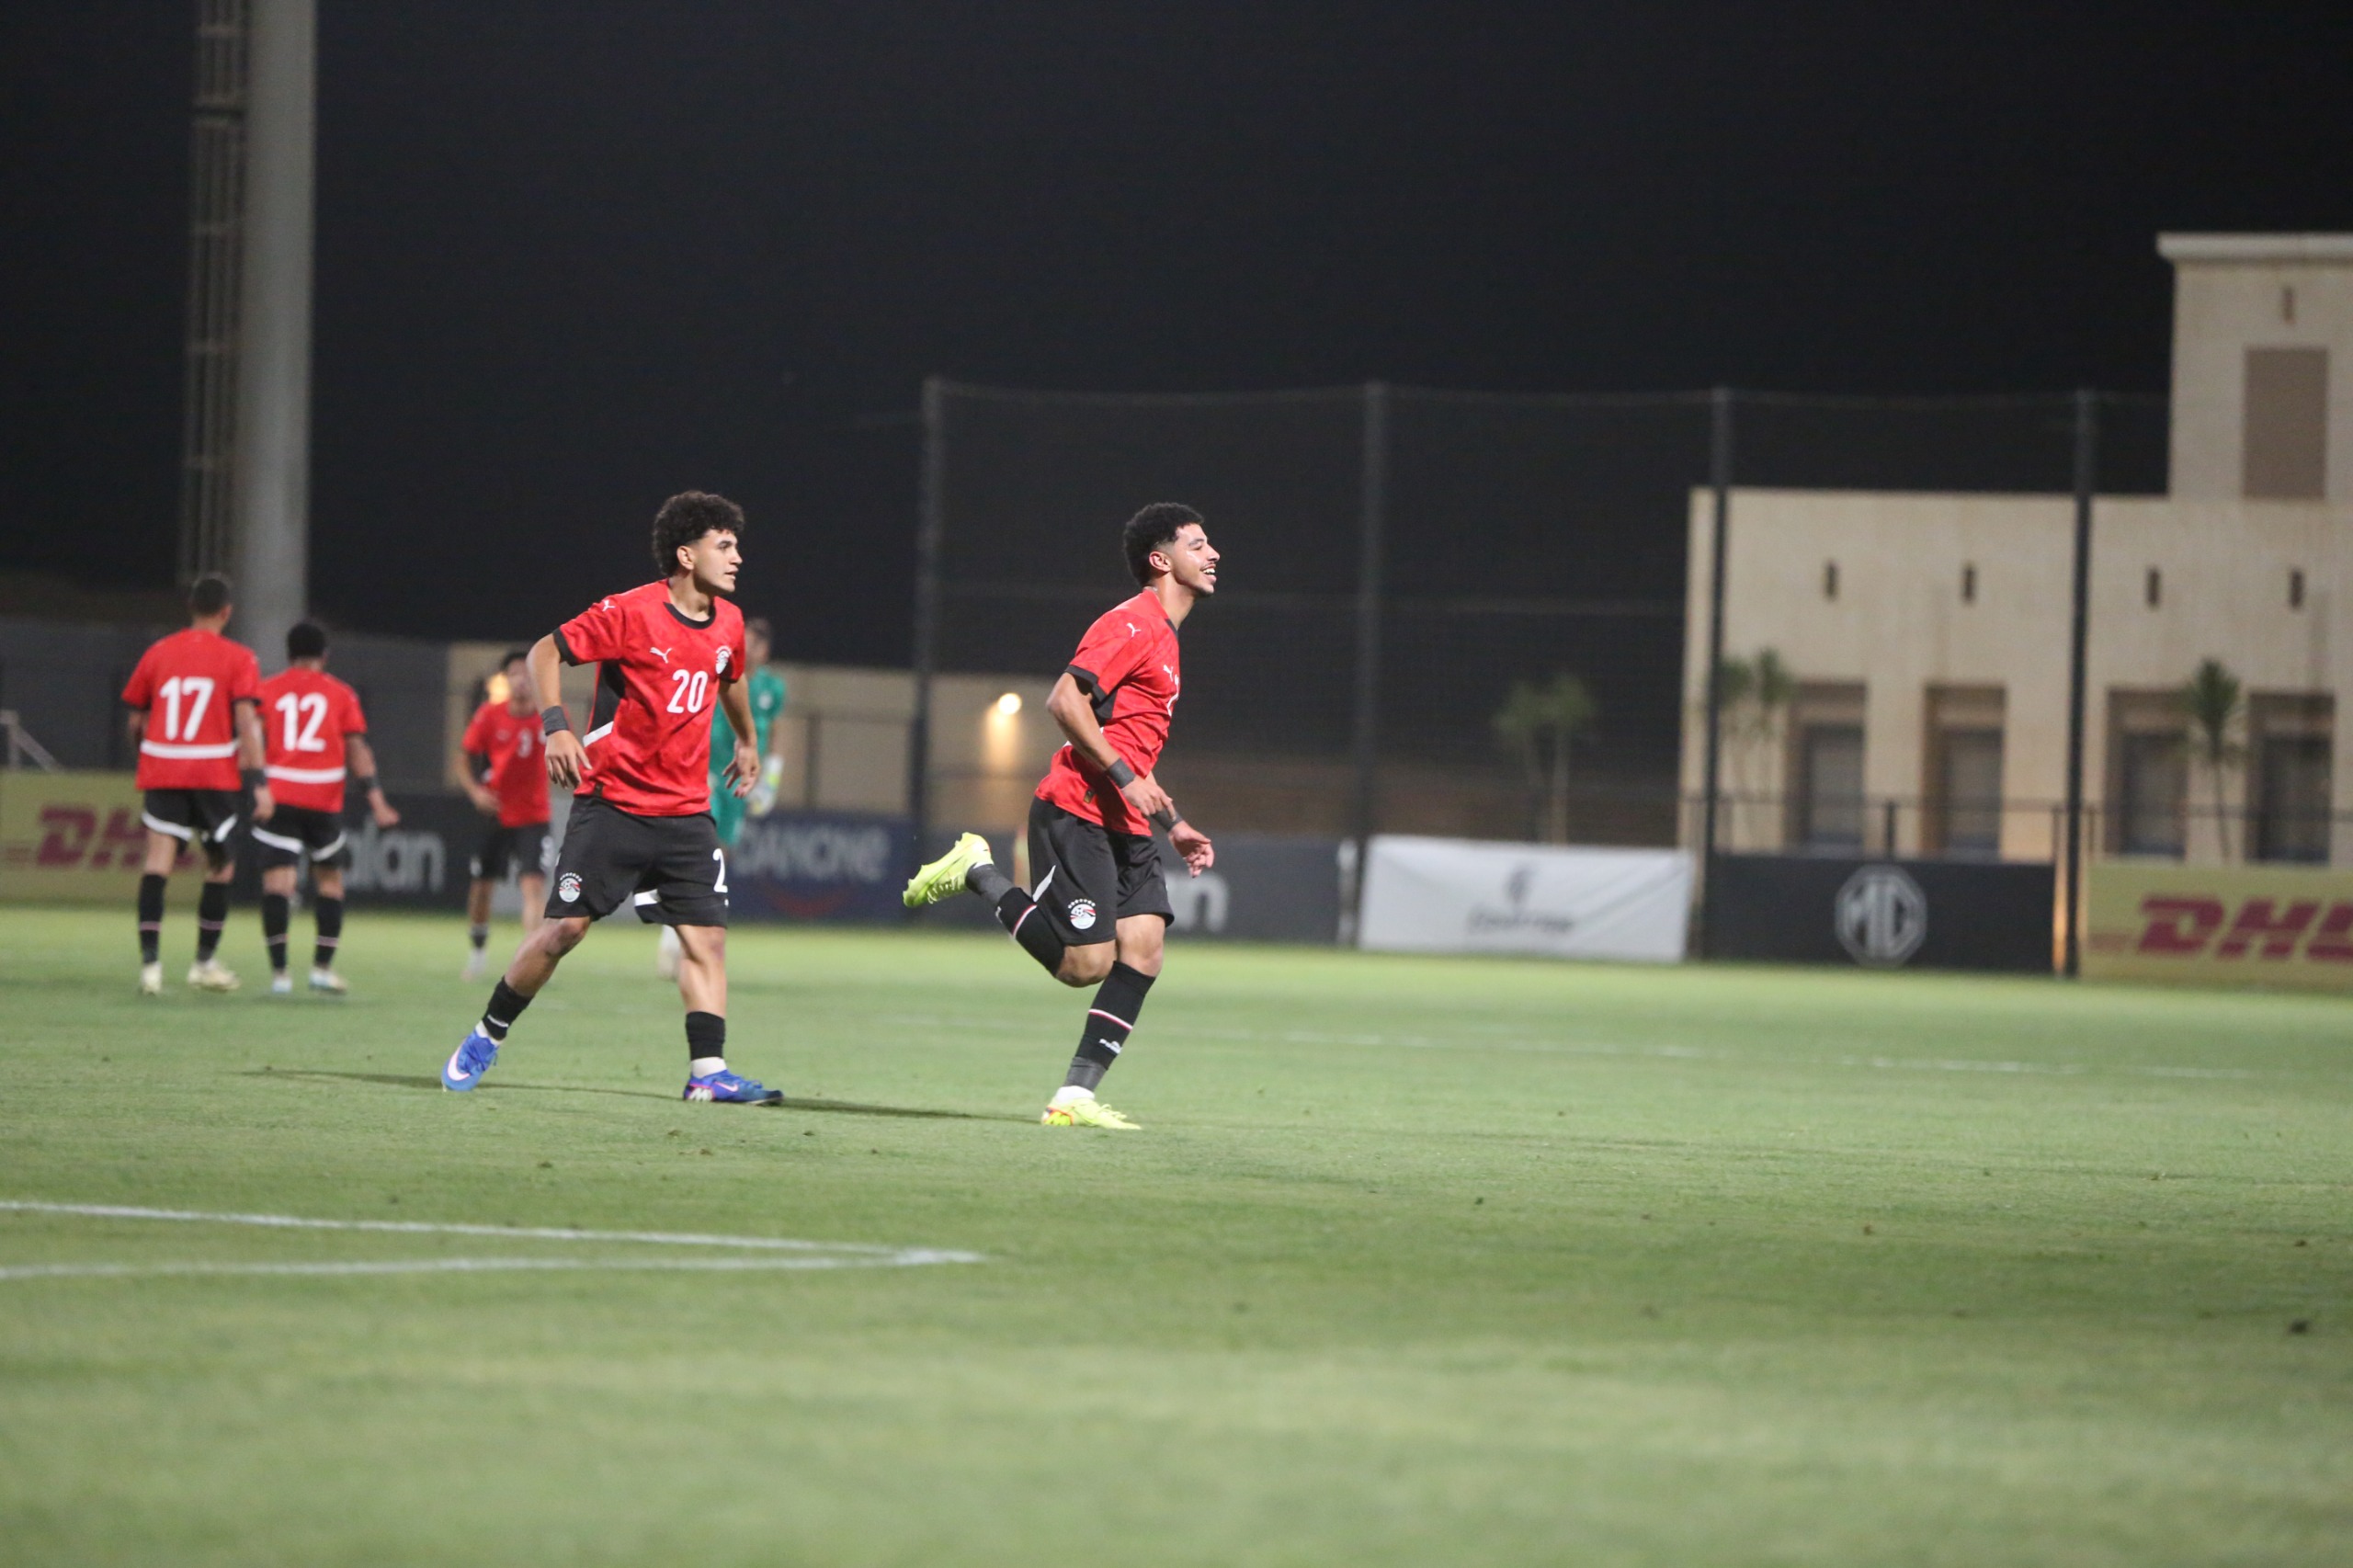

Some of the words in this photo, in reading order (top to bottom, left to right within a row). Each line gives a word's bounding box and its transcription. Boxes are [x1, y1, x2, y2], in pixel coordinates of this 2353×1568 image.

[159, 676, 215, 742] 17
[275, 691, 328, 752] 12
[666, 669, 709, 714] 20
